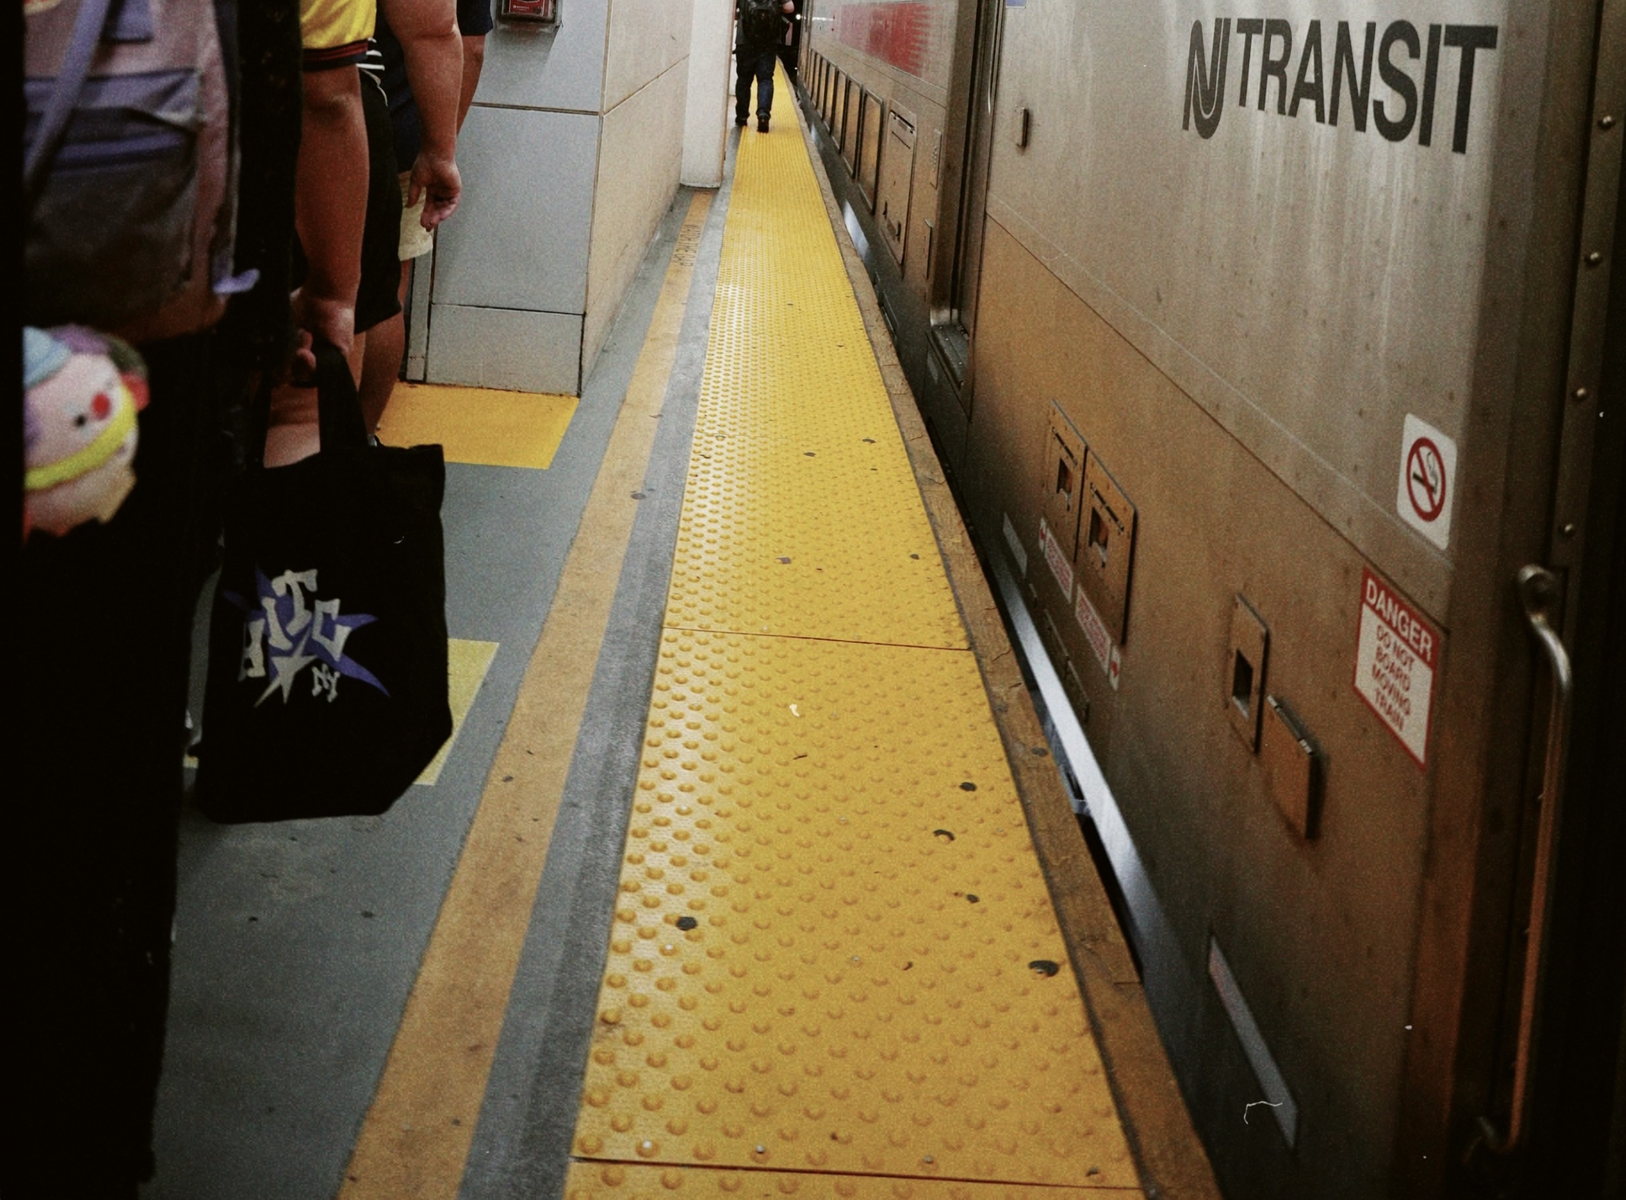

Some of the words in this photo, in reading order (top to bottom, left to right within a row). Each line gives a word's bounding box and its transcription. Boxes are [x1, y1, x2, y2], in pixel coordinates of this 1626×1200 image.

[1236, 17, 1498, 155] TRANSIT
[1365, 578, 1433, 662] DANGER
[1375, 646, 1412, 693] BOARD
[1376, 624, 1391, 649] DO
[1393, 639, 1415, 672] NOT
[1371, 663, 1412, 717] MOVING
[1374, 687, 1405, 732] TRAIN
